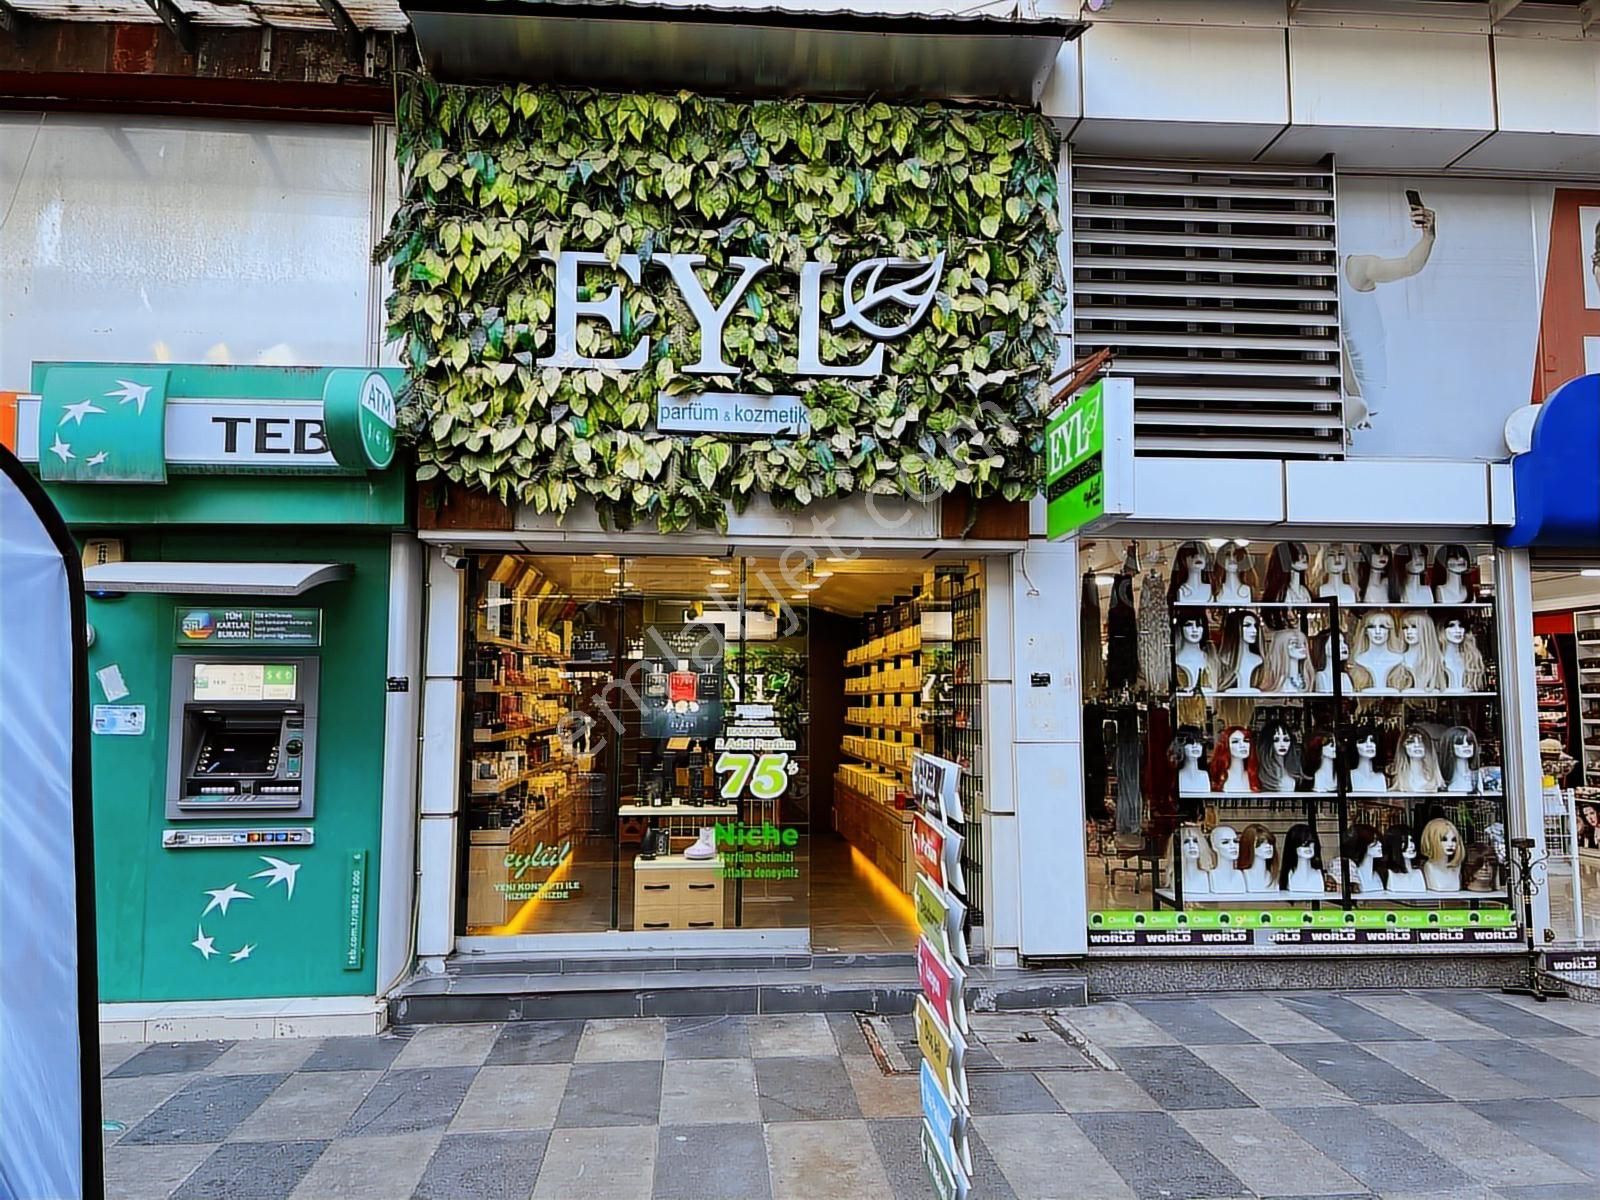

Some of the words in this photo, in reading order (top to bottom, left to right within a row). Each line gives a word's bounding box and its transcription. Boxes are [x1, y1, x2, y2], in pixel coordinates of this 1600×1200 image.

[537, 251, 884, 377] EYL
[368, 383, 391, 421] ATM
[660, 403, 718, 423] parfüm
[724, 411, 731, 421] &
[735, 404, 808, 423] kozmetik
[212, 416, 330, 454] TEB
[1049, 408, 1089, 476] EYL
[755, 738, 796, 750] Parfüm
[715, 822, 799, 846] Niche
[503, 841, 570, 879] eylül
[753, 866, 799, 880] deneyiniz
[1090, 935, 1135, 943] WORLD
[1146, 934, 1191, 943] WORLD
[1202, 933, 1247, 942] WORLD
[1311, 932, 1356, 941] WORLD
[1367, 932, 1411, 941] WORLD
[1420, 931, 1464, 940] WORLD
[1474, 931, 1518, 939] WORLD
[1553, 961, 1597, 970] WORLD
